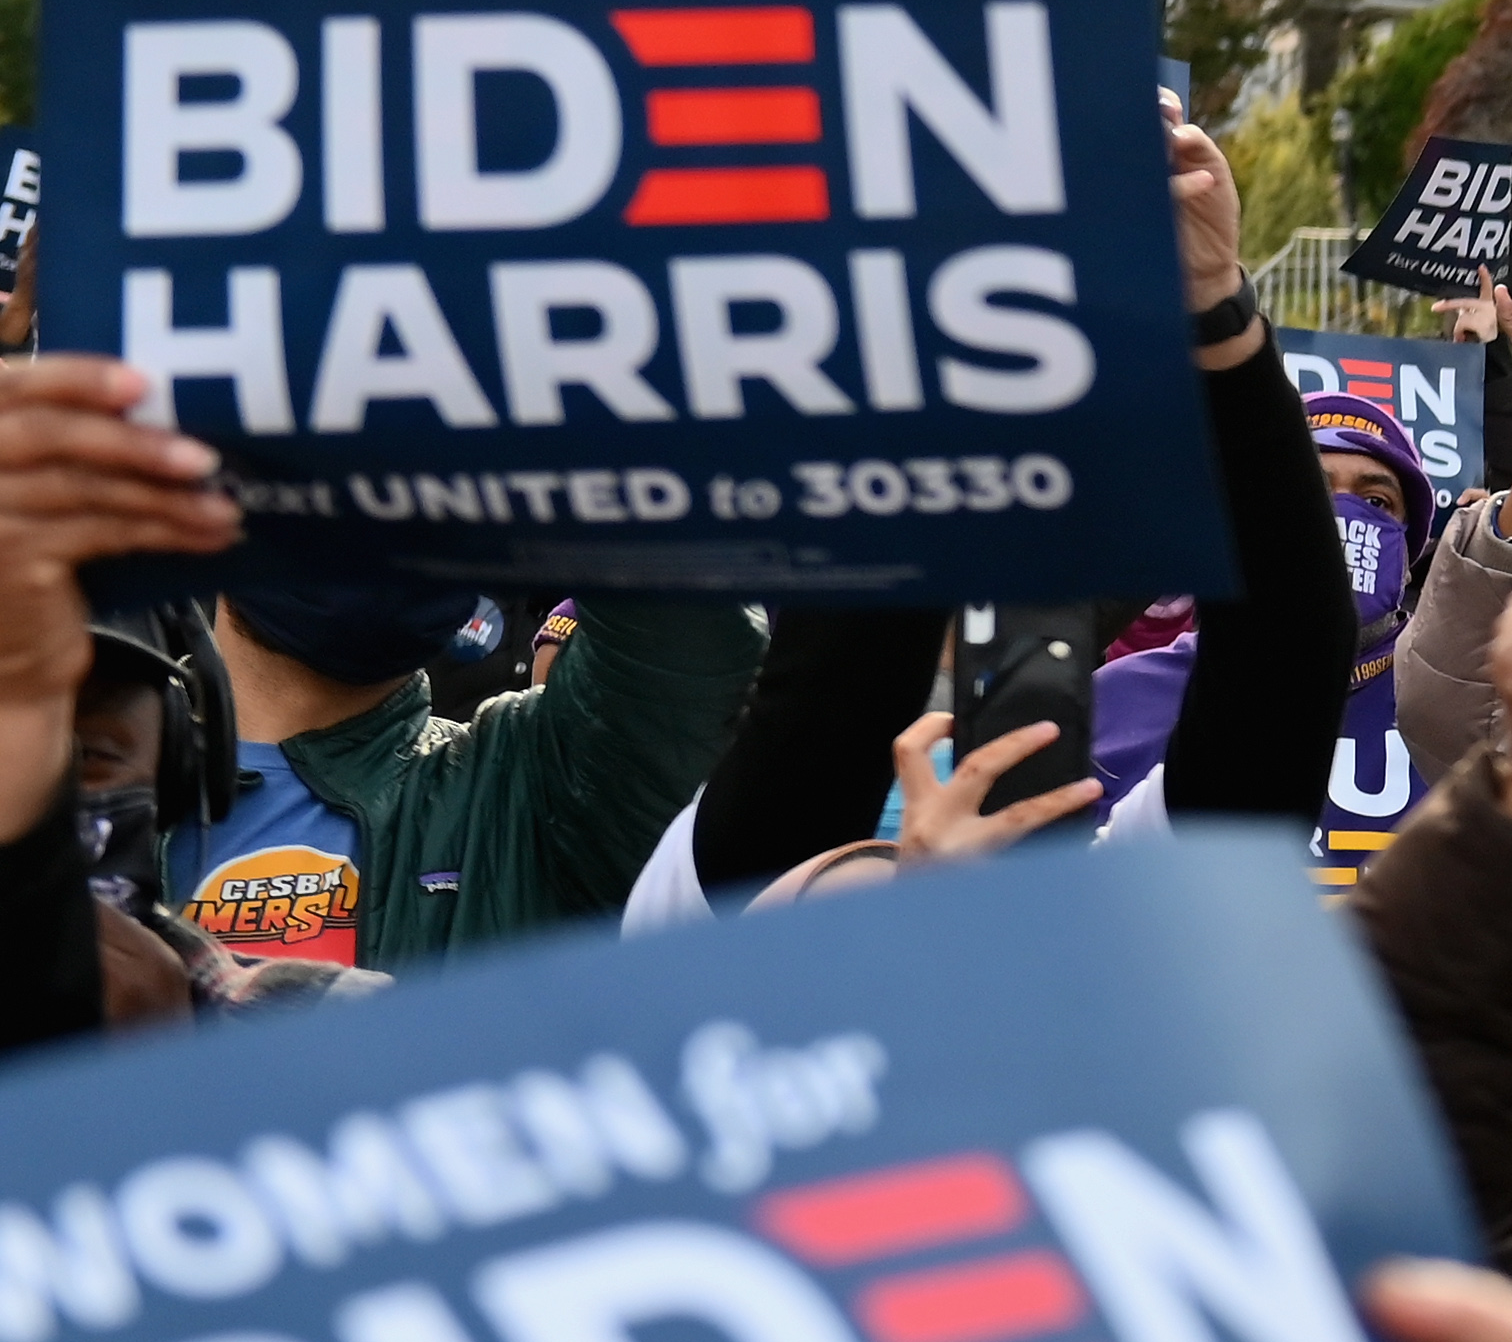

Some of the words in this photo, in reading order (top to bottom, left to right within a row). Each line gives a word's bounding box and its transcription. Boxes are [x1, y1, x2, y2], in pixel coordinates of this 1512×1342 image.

[1420, 259, 1482, 288] UNITE
[122, 244, 1098, 435] HARRIS
[1281, 350, 1456, 427] DEN
[350, 465, 691, 525] UNITED
[710, 473, 782, 519] to
[794, 455, 1074, 519] 30330
[678, 1017, 890, 1196] for
